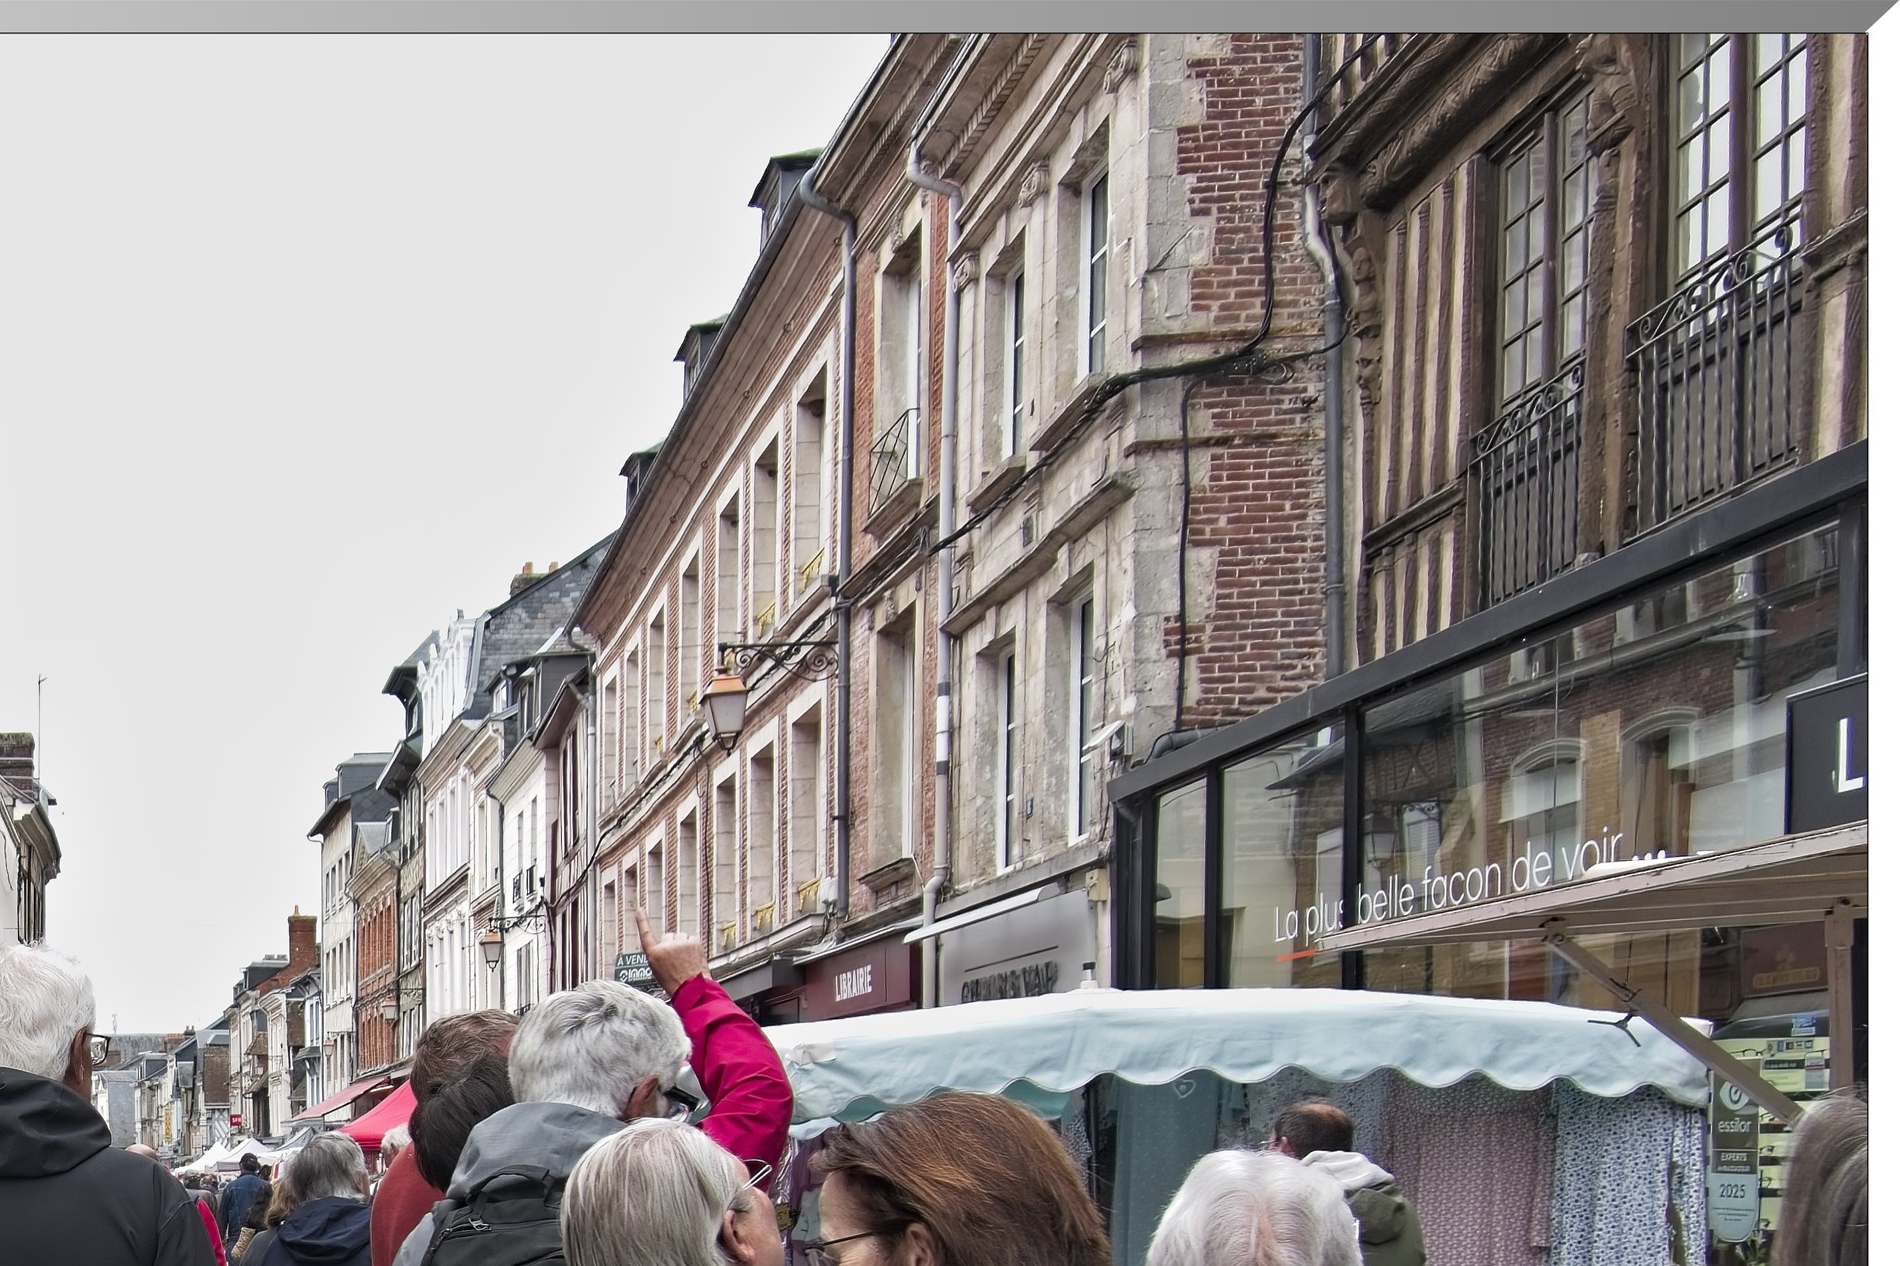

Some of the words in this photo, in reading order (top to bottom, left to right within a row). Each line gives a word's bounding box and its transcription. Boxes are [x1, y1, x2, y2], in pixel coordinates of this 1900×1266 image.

[1837, 717, 1864, 793] L
[1274, 906, 1299, 942] La
[1358, 873, 1415, 924] belle
[1512, 840, 1552, 892] de
[1562, 826, 1624, 881] voir
[835, 964, 873, 1002] LIBRAIRIE
[1718, 1117, 1752, 1133] essilor
[1719, 1183, 1746, 1199] 2025
